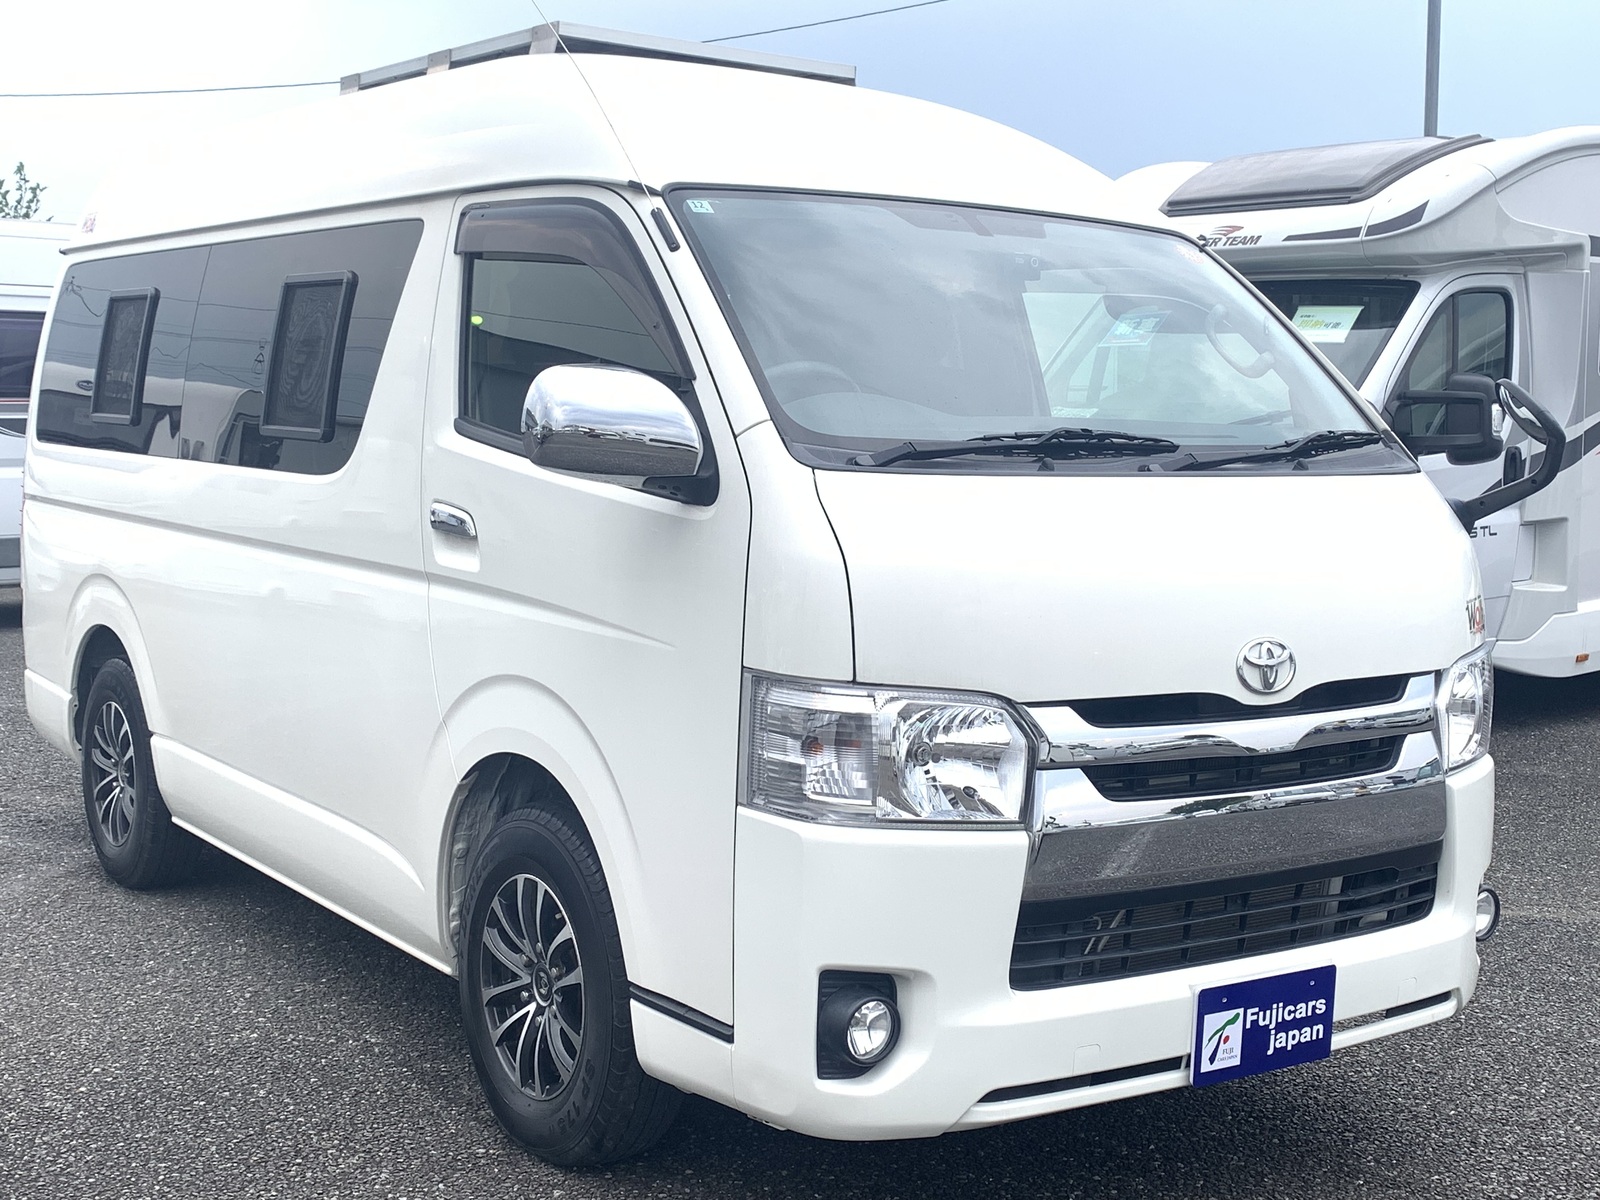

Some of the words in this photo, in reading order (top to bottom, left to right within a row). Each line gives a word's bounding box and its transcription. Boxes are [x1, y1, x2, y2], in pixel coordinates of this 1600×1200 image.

[1223, 235, 1262, 246] TEAM
[1480, 525, 1498, 537] TL
[1246, 998, 1327, 1029] Fujicars
[1267, 1023, 1325, 1055] japan
[1222, 1047, 1234, 1055] FUJI
